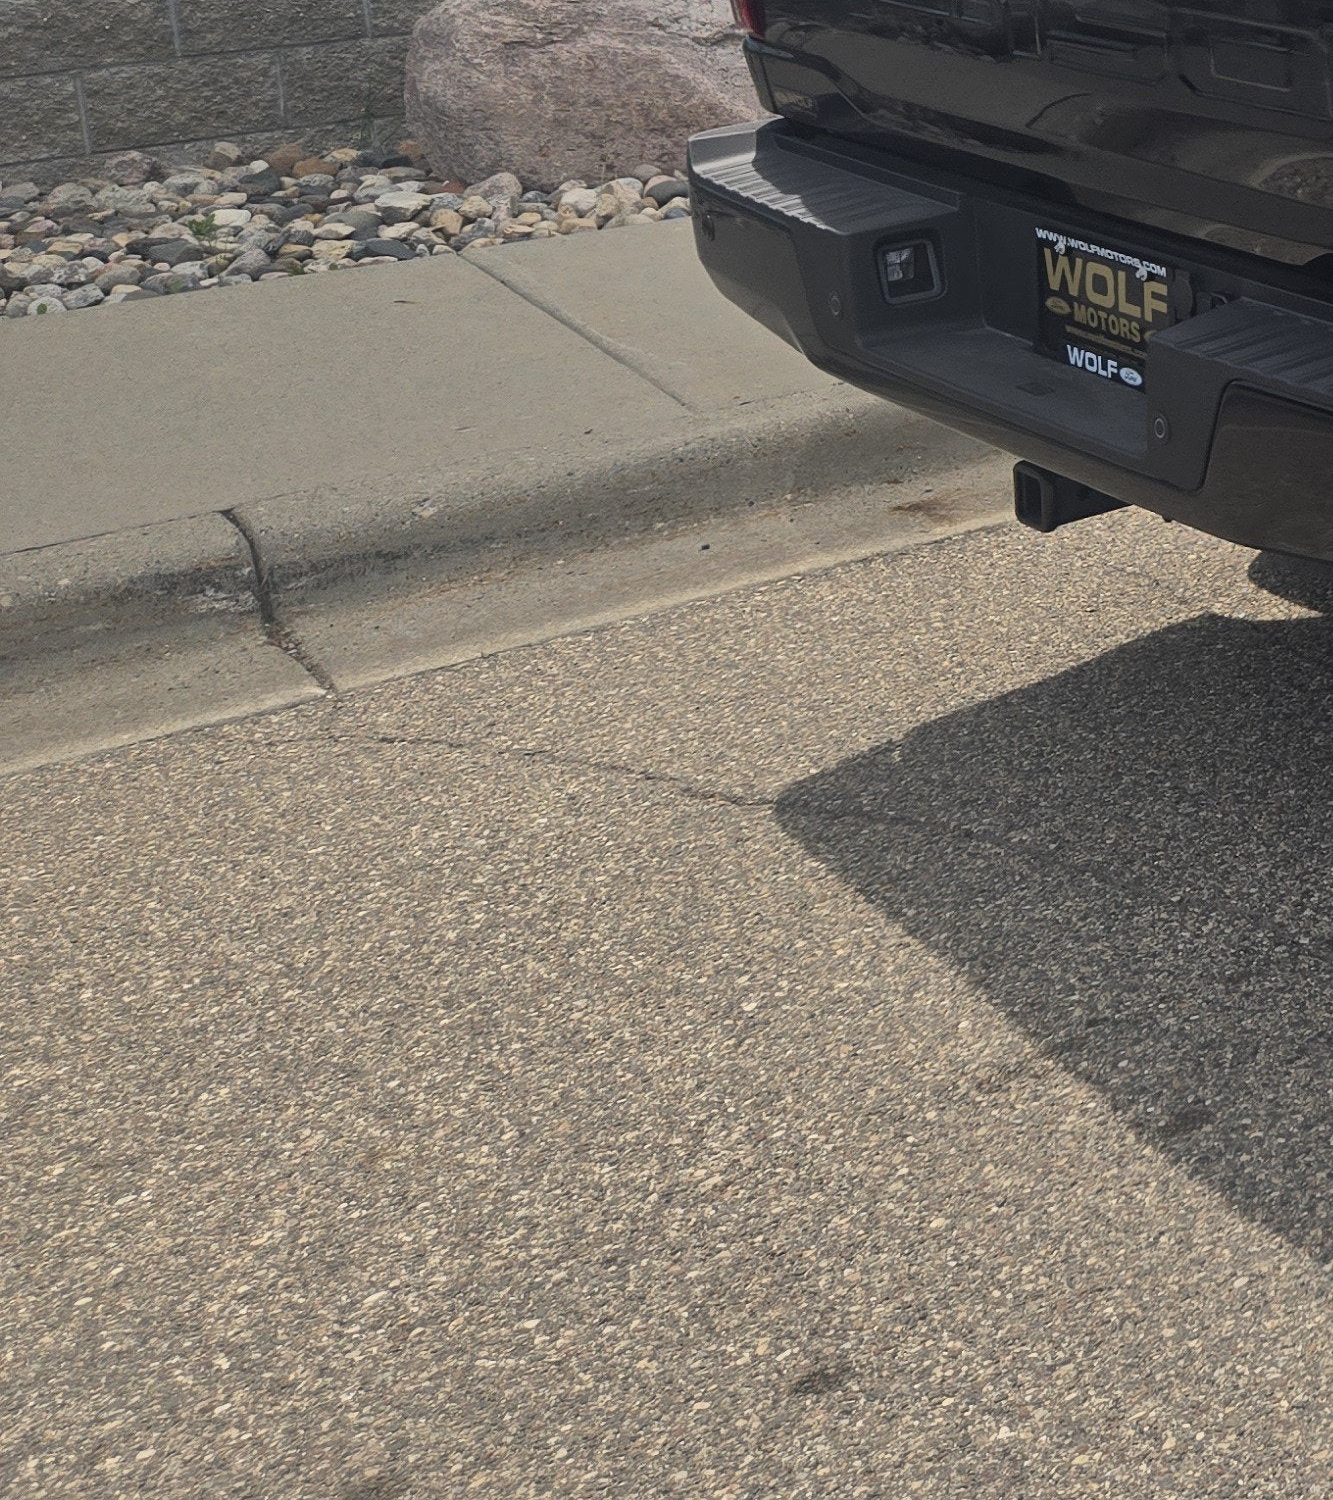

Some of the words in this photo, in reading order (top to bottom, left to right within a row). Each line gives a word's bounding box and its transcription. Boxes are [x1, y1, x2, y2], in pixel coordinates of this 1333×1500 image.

[1044, 247, 1168, 322] WOLF
[1073, 302, 1141, 343] MOTORS
[1067, 345, 1119, 379] WOLF
